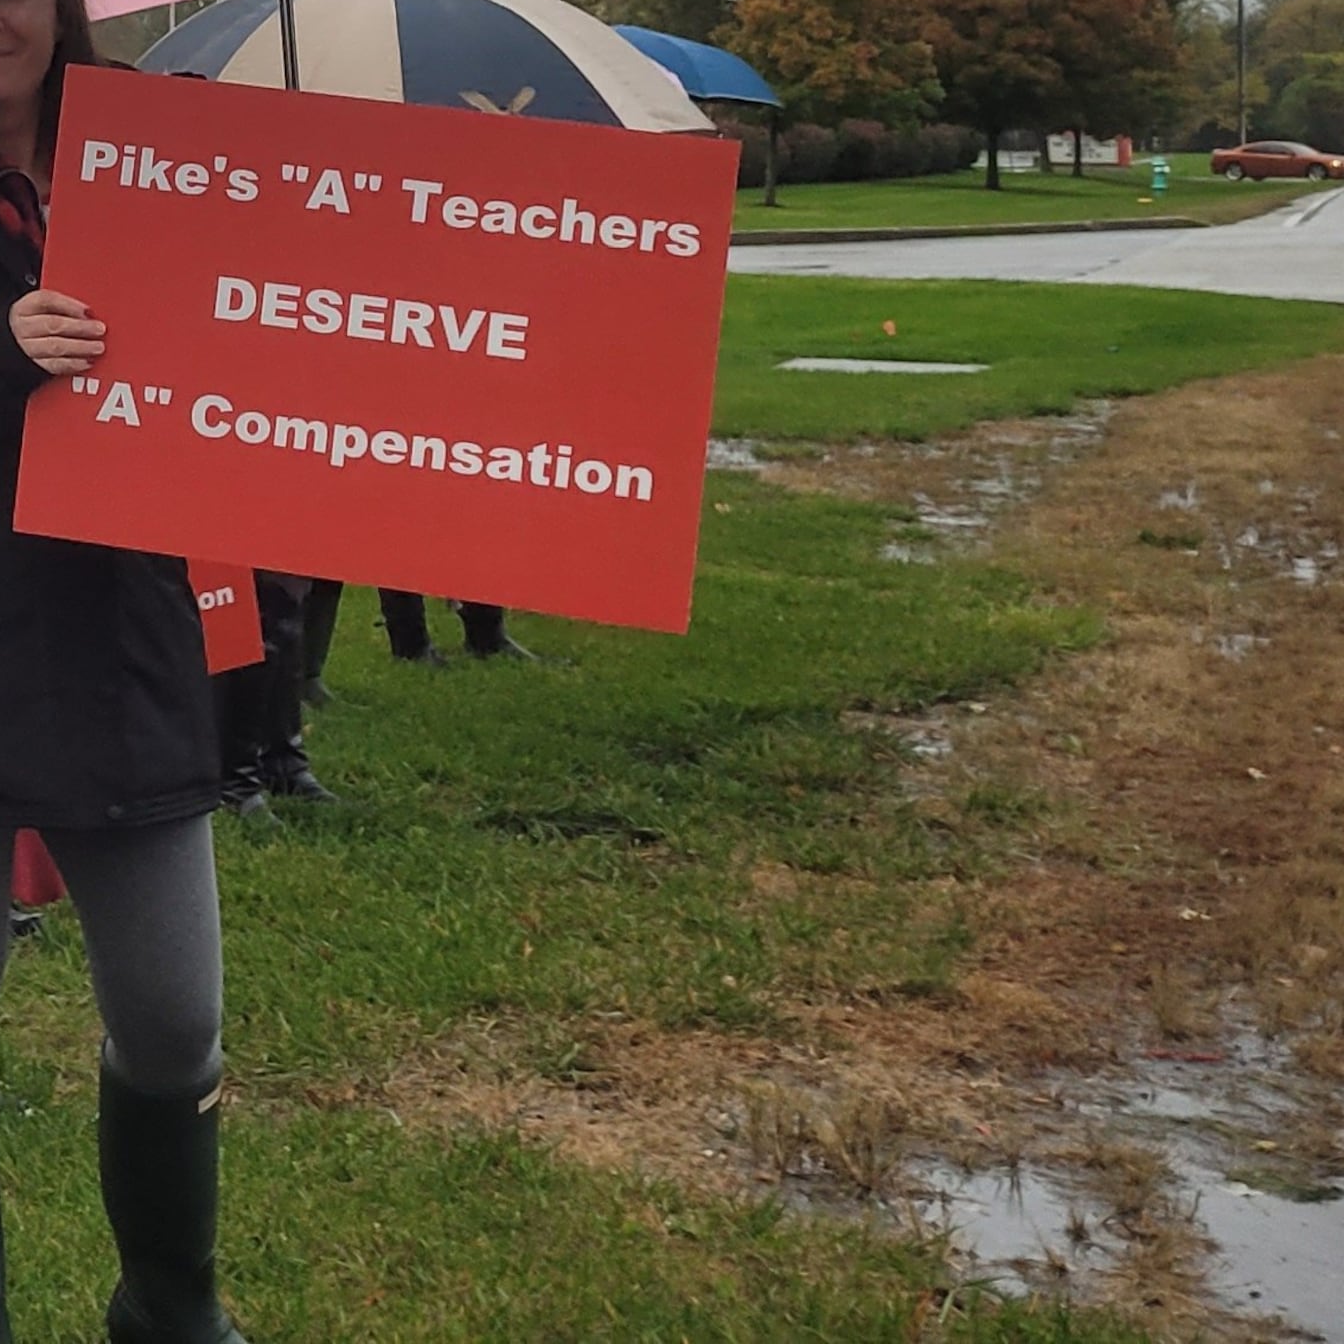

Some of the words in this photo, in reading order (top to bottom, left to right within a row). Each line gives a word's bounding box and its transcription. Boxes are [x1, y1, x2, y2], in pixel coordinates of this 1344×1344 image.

[81, 141, 259, 202] Pike's
[281, 164, 382, 214] "A"
[402, 179, 700, 257] Teachers
[214, 276, 529, 360] DESERVE
[71, 376, 172, 426] "A"
[191, 394, 653, 501] Compensation
